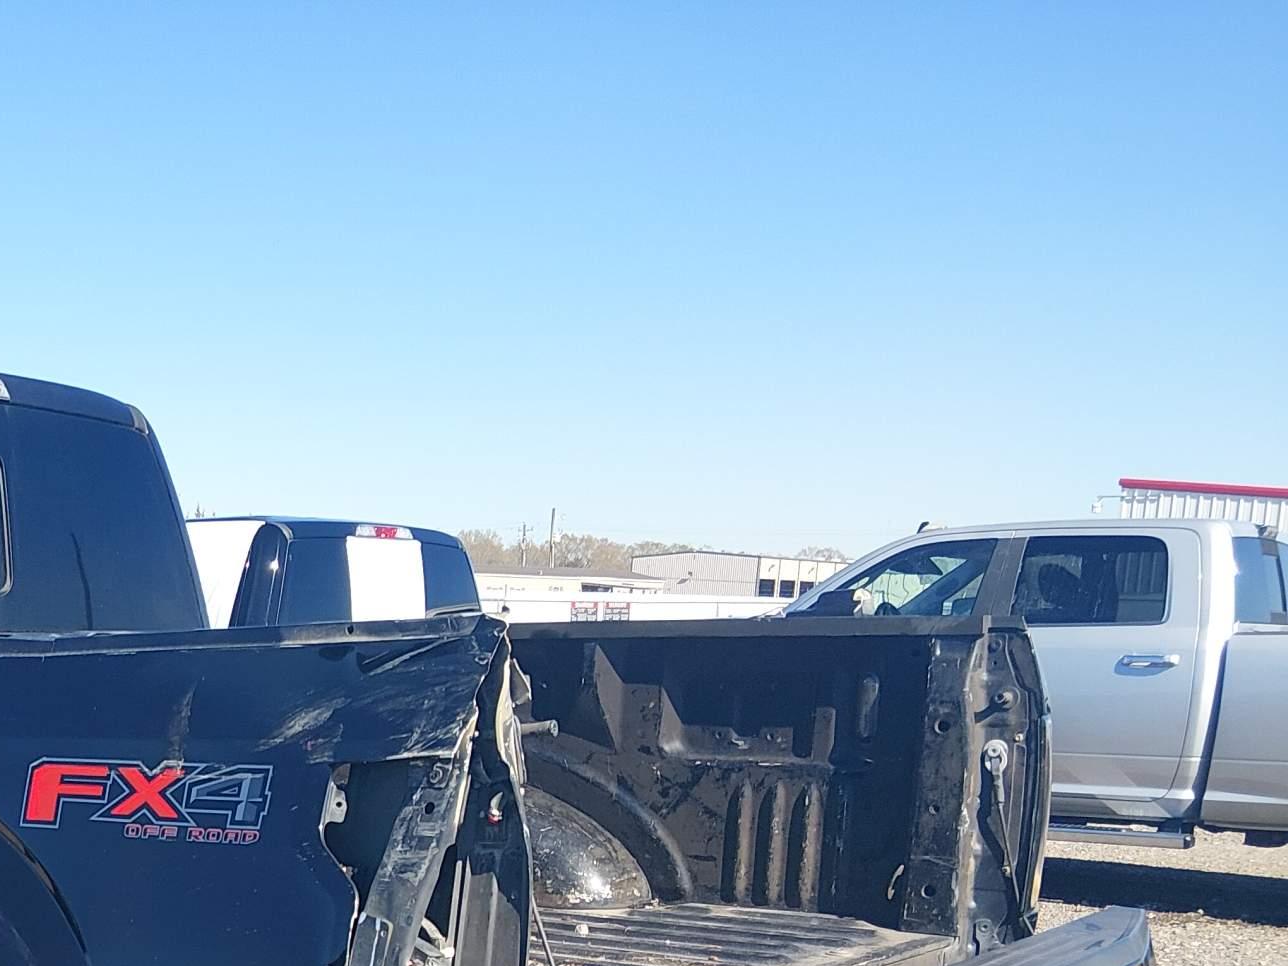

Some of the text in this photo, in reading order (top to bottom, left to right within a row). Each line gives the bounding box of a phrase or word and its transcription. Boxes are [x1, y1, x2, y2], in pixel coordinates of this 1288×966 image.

[20, 757, 273, 829] FX4
[123, 823, 260, 845] OFF ROAD
